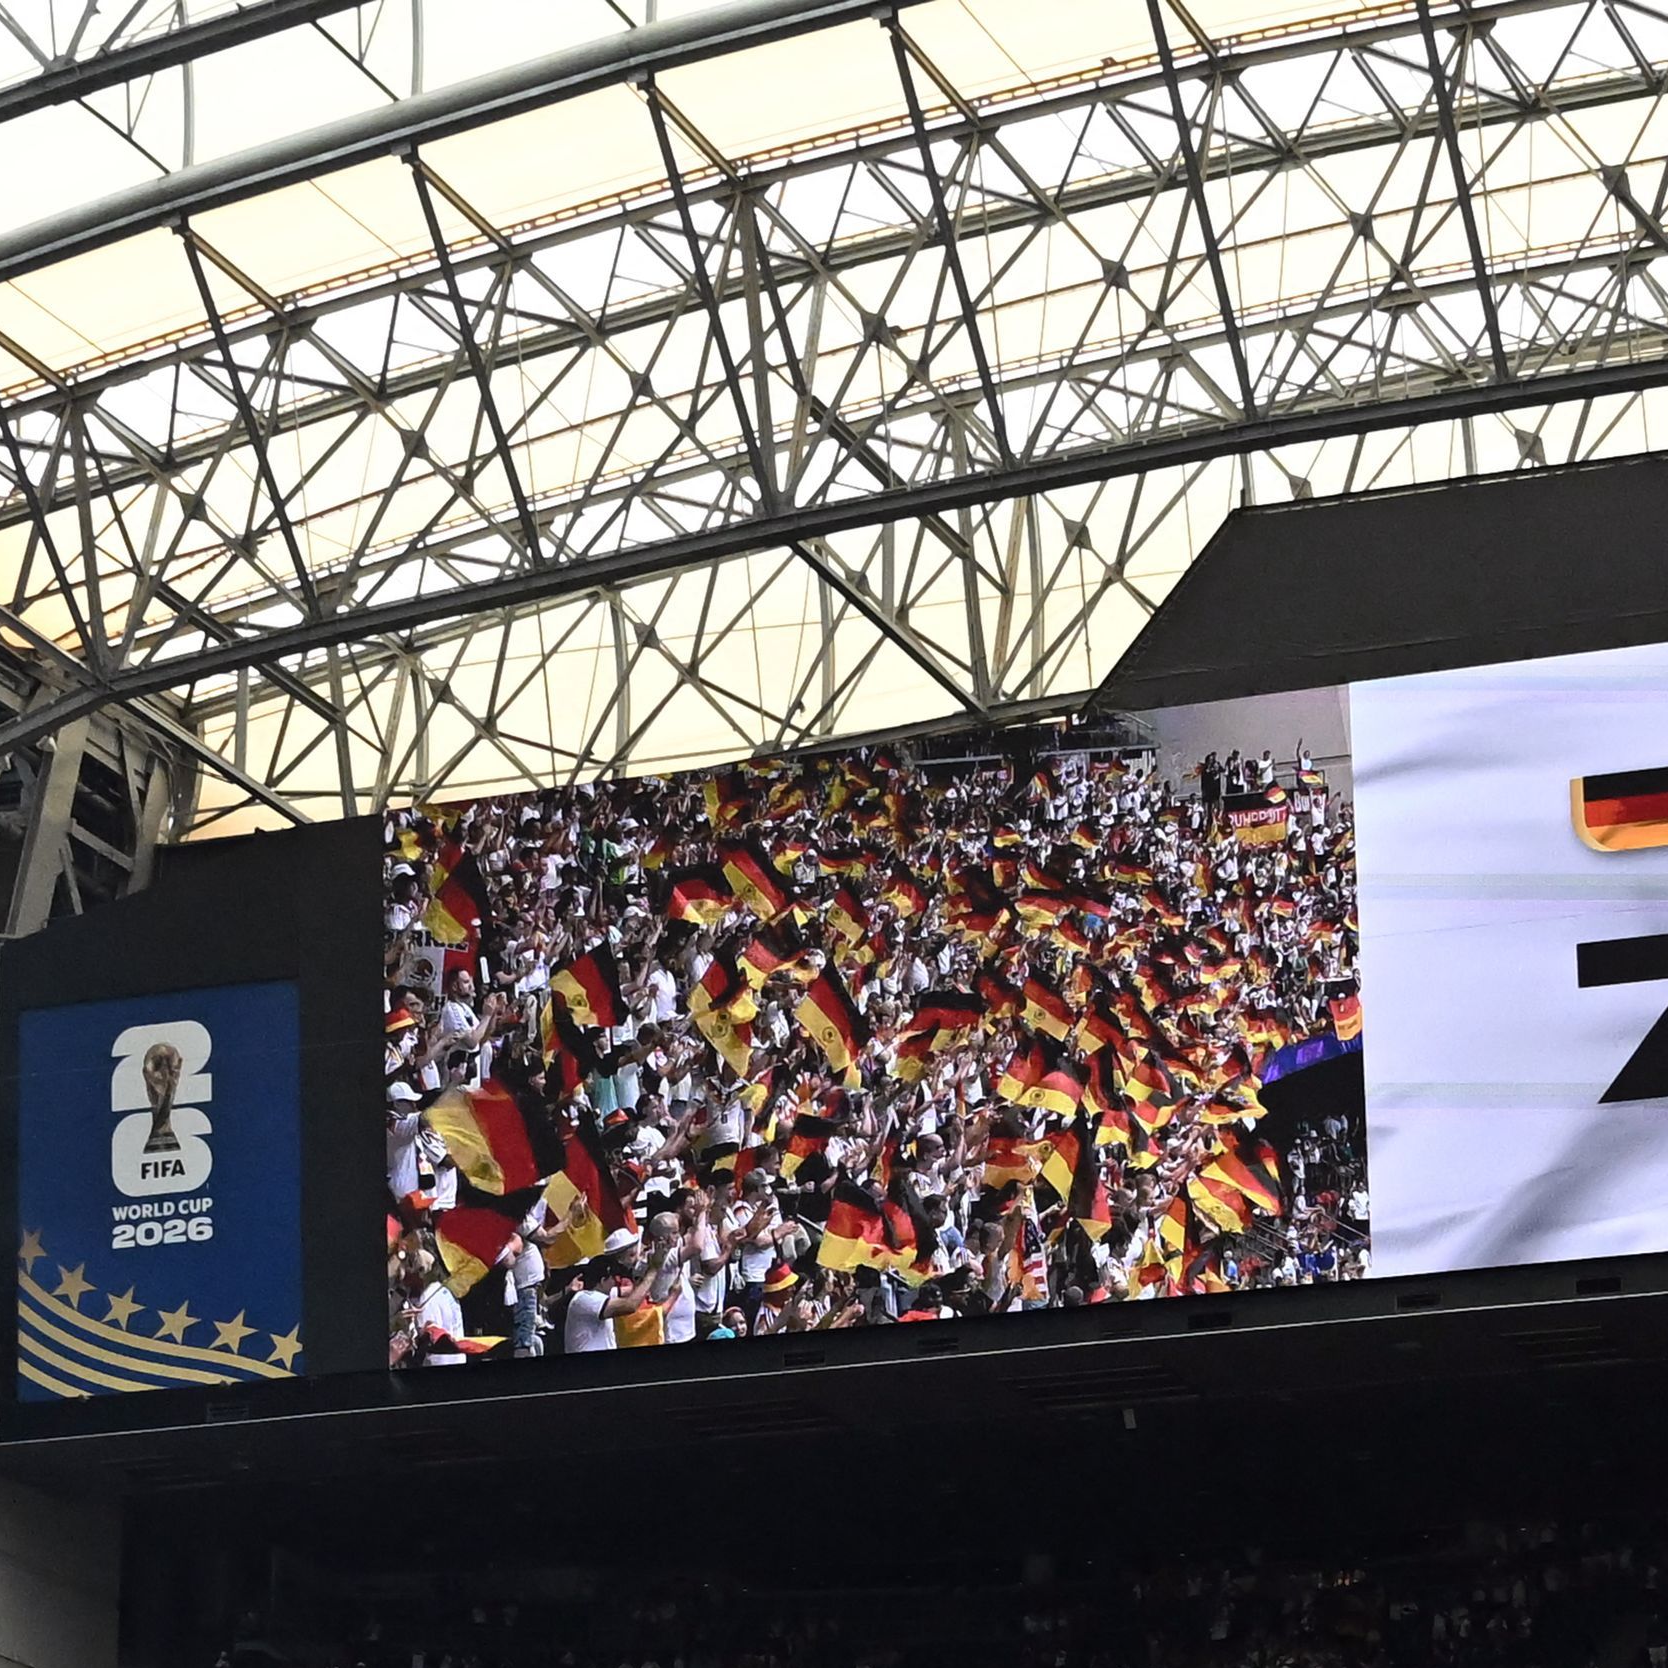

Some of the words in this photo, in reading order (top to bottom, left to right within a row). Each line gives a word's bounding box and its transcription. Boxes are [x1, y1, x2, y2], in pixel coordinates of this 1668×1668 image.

[141, 1159, 186, 1180] FIFA
[112, 1201, 175, 1221] WORLD
[178, 1198, 213, 1215] CUP
[112, 1216, 213, 1249] 2026
